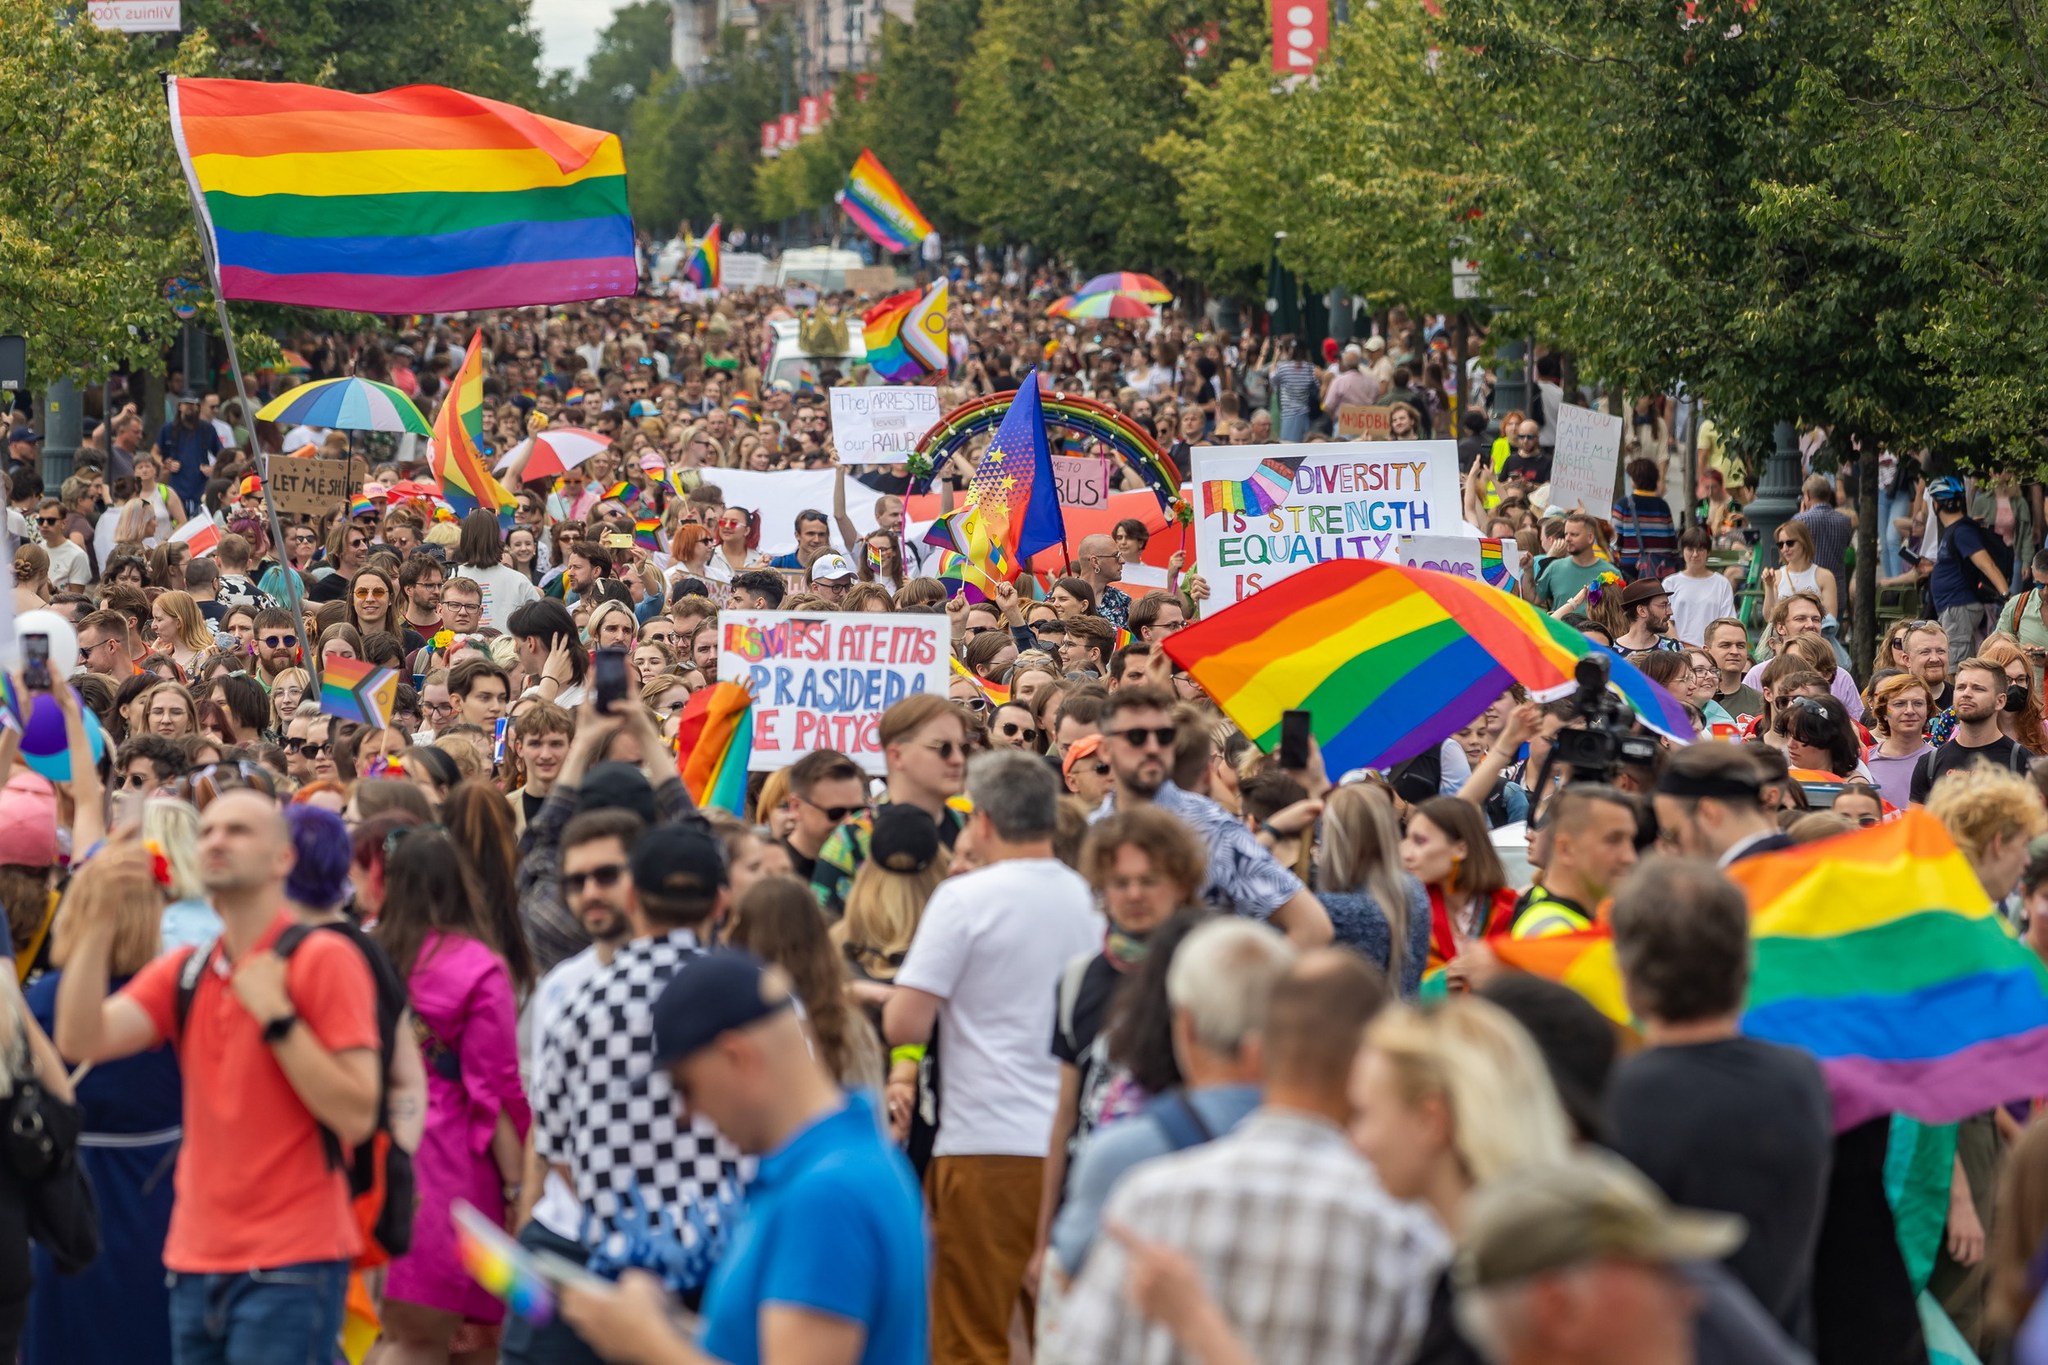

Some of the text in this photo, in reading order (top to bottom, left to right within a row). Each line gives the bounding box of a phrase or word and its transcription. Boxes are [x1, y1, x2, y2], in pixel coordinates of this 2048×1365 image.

[836, 392, 937, 415] They ARRESTED
[1586, 411, 1611, 428] YOU
[1555, 450, 1592, 468] RIGHTS
[1592, 444, 1613, 458] MY
[1068, 462, 1081, 473] TO
[1296, 461, 1427, 495] DIVERSITY
[273, 474, 299, 492] LET
[302, 477, 325, 495] ME
[1222, 500, 1430, 535] IS STRENGTH
[1219, 533, 1392, 567] EQUALITY
[1235, 573, 1264, 602] IS
[741, 618, 937, 665] ŠVIESI ATEITIS
[752, 710, 780, 750] E
